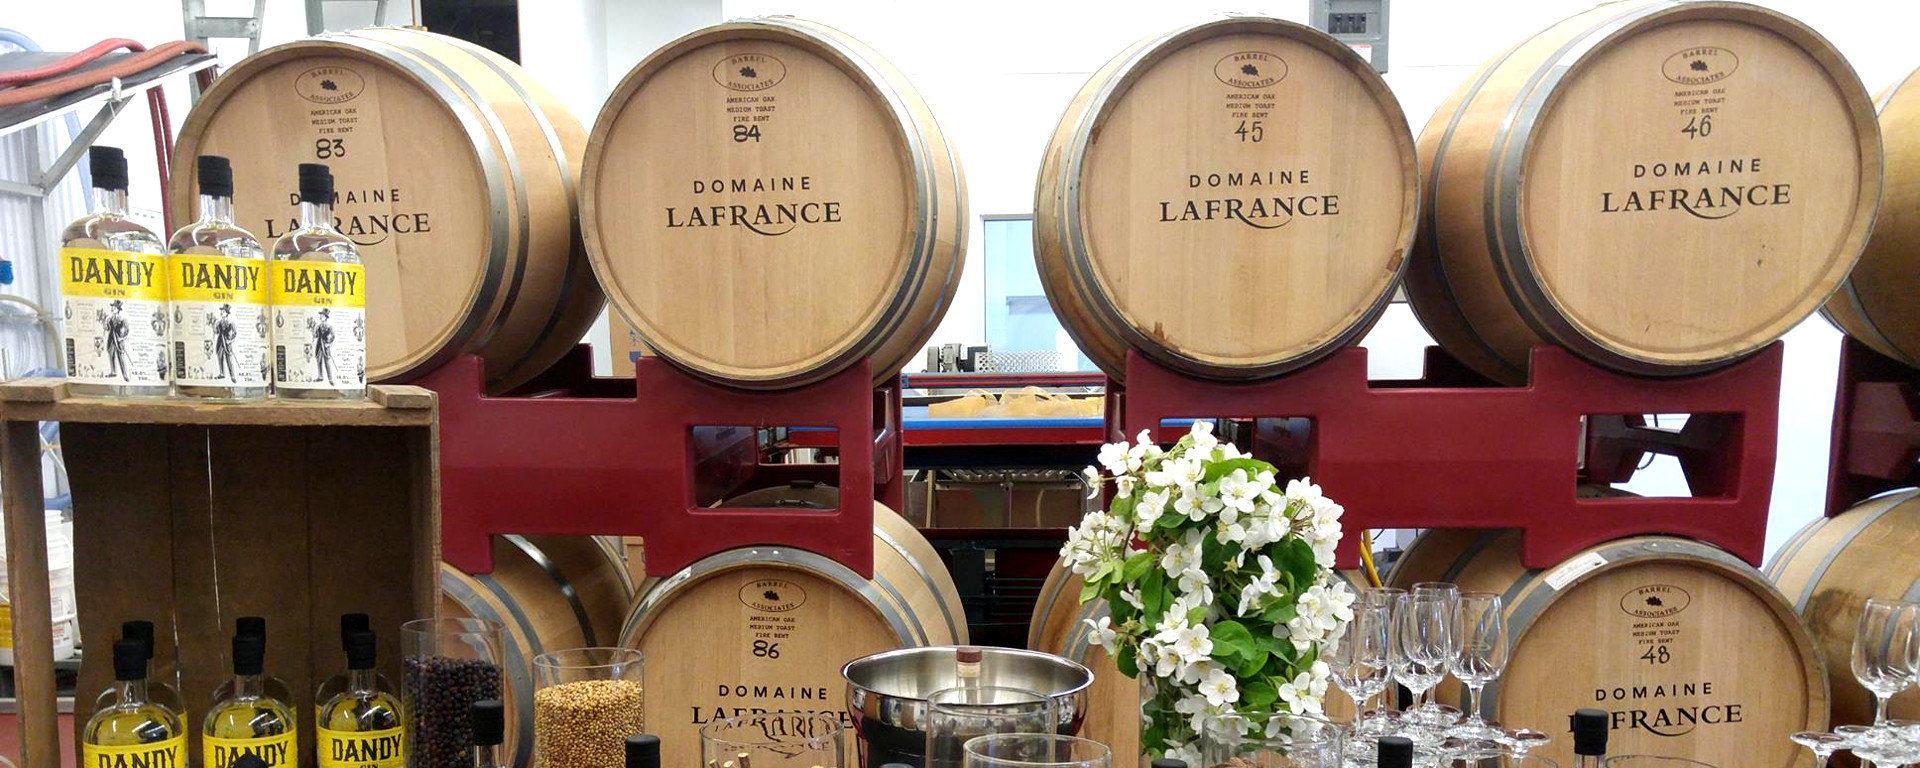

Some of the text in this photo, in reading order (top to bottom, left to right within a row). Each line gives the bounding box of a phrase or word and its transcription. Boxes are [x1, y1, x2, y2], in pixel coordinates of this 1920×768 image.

[733, 125, 761, 142] 84
[1235, 120, 1263, 142] 45
[1681, 115, 1712, 140] 46
[316, 138, 345, 159] 83
[1634, 158, 1761, 178] DOMAINE
[694, 176, 810, 193] DOMAINE
[1190, 170, 1309, 187] DOMAINE
[291, 189, 400, 206] DAINE
[1601, 184, 1791, 219] LAFRANCE
[666, 202, 842, 236] LAFRANCE
[1160, 195, 1340, 229] LAFRANCE
[264, 213, 431, 246] LARANCE
[71, 256, 155, 287] DANDY
[181, 262, 260, 290] DANDY
[284, 267, 357, 295] DANDY
[104, 288, 126, 297] GIN
[213, 292, 233, 300] GIN
[1638, 587, 1671, 595] BARREL
[753, 640, 779, 659] 86
[1640, 645, 1671, 664] 48
[719, 685, 827, 699] DOMAINE
[1595, 682, 1711, 701] DOMAINE
[332, 734, 401, 762] DANDY
